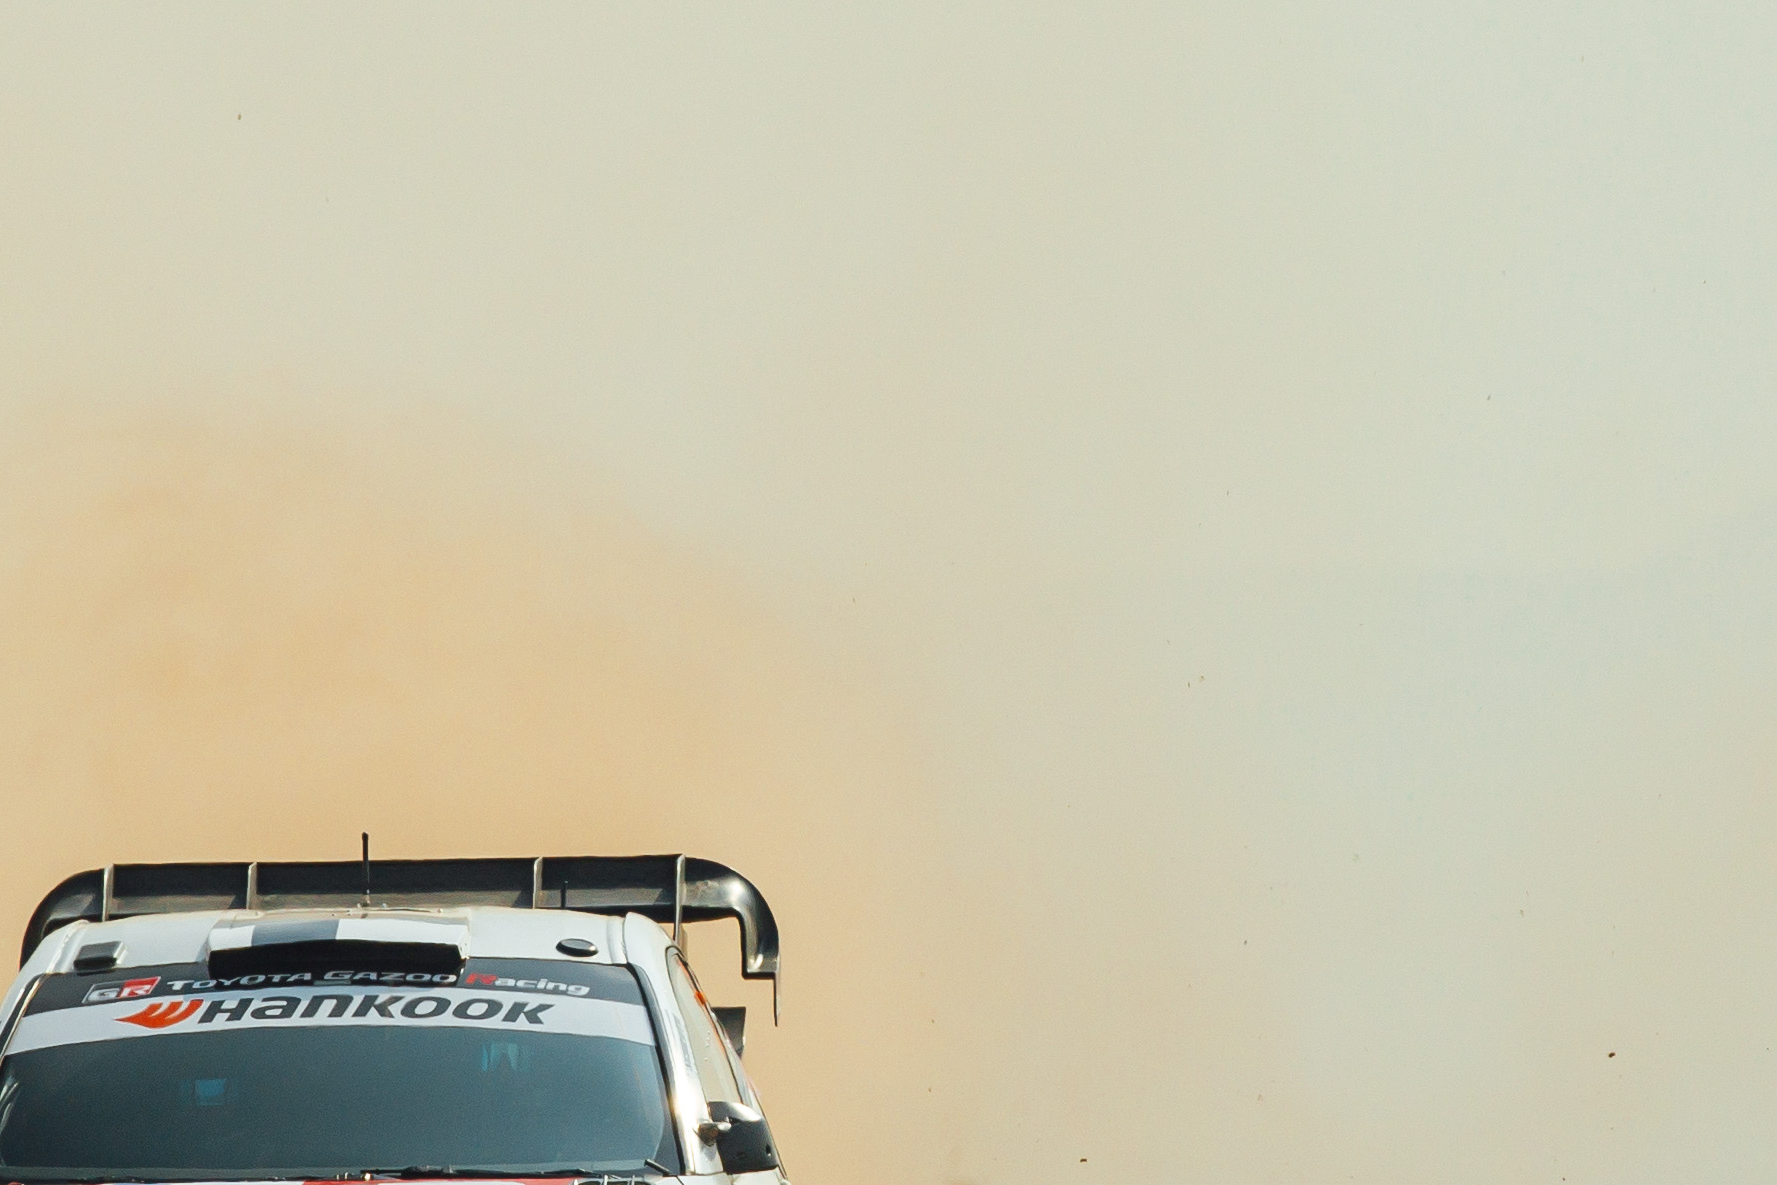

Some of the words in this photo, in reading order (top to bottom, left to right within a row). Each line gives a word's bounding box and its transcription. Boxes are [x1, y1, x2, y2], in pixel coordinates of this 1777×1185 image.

[85, 981, 156, 1003] GR
[166, 972, 312, 991] TOYOTA
[323, 970, 457, 983] GAZOO
[466, 972, 590, 996] Racing
